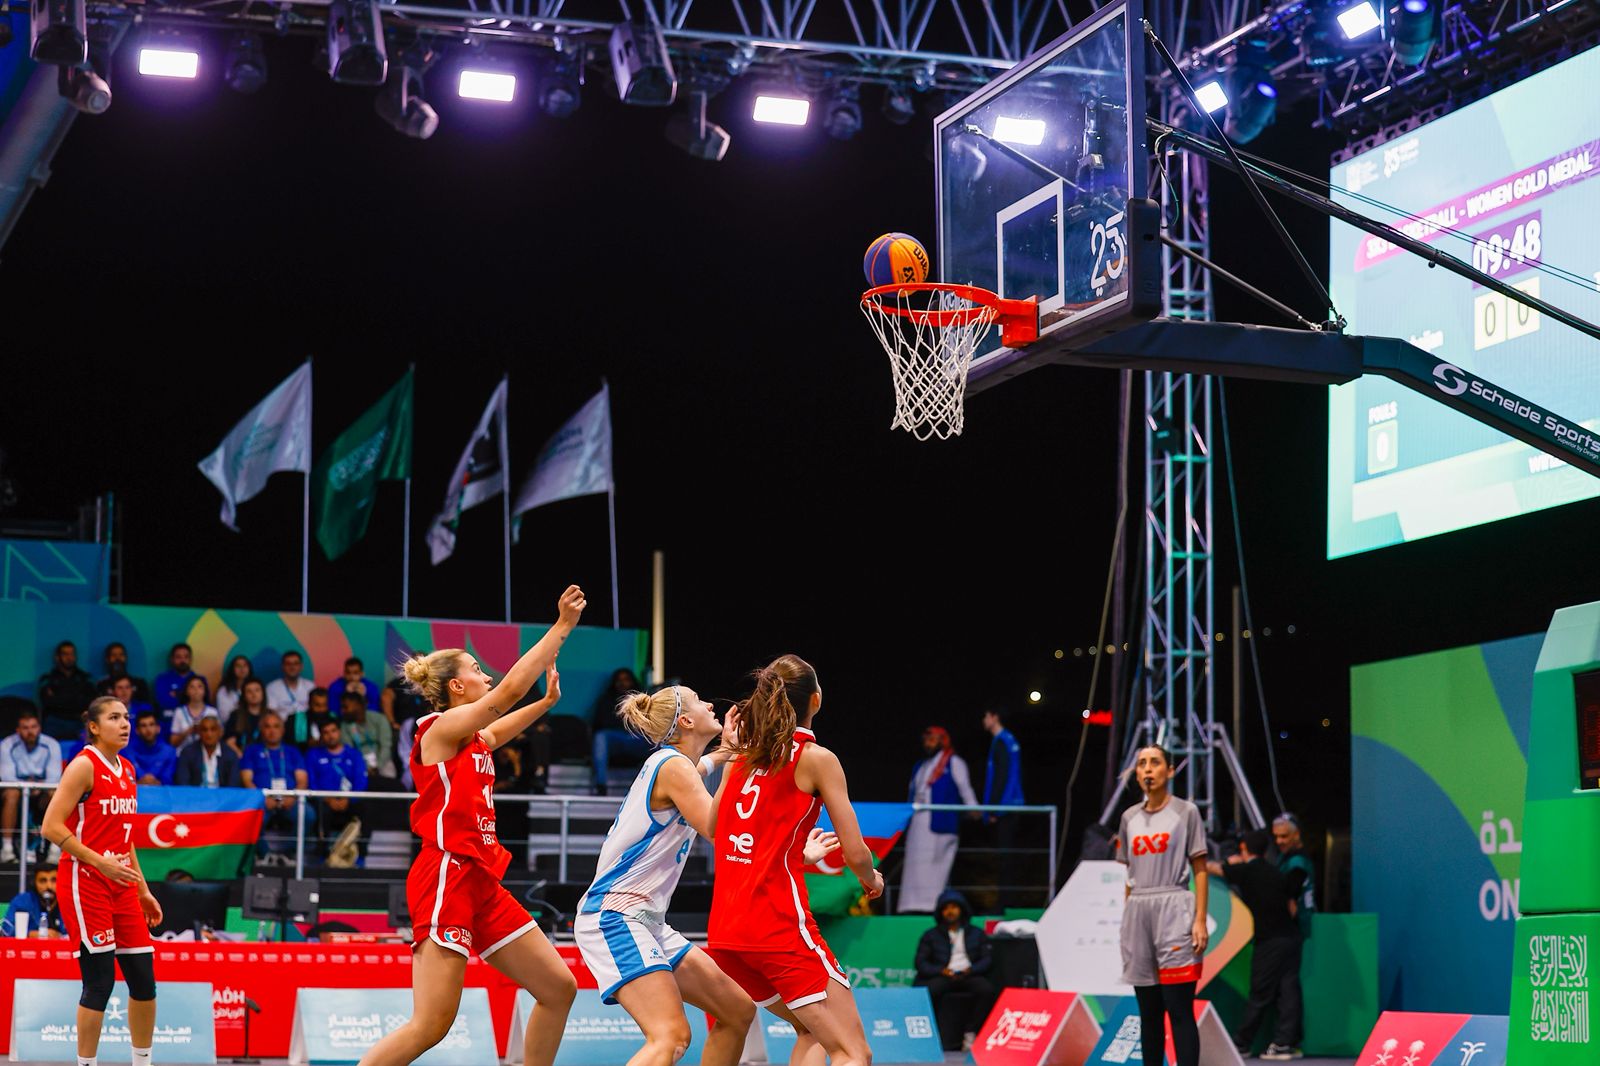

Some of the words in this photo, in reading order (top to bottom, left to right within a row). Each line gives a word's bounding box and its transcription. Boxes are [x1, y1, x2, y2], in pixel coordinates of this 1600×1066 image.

[1466, 182, 1512, 218] WOMEN
[1513, 169, 1548, 199] GOLD
[1548, 151, 1593, 186] MEDAL
[1473, 219, 1541, 275] 09:48
[1470, 380, 1541, 424] Schelde
[1544, 416, 1600, 453] Sports
[735, 768, 769, 820] 5
[122, 822, 133, 844] 7
